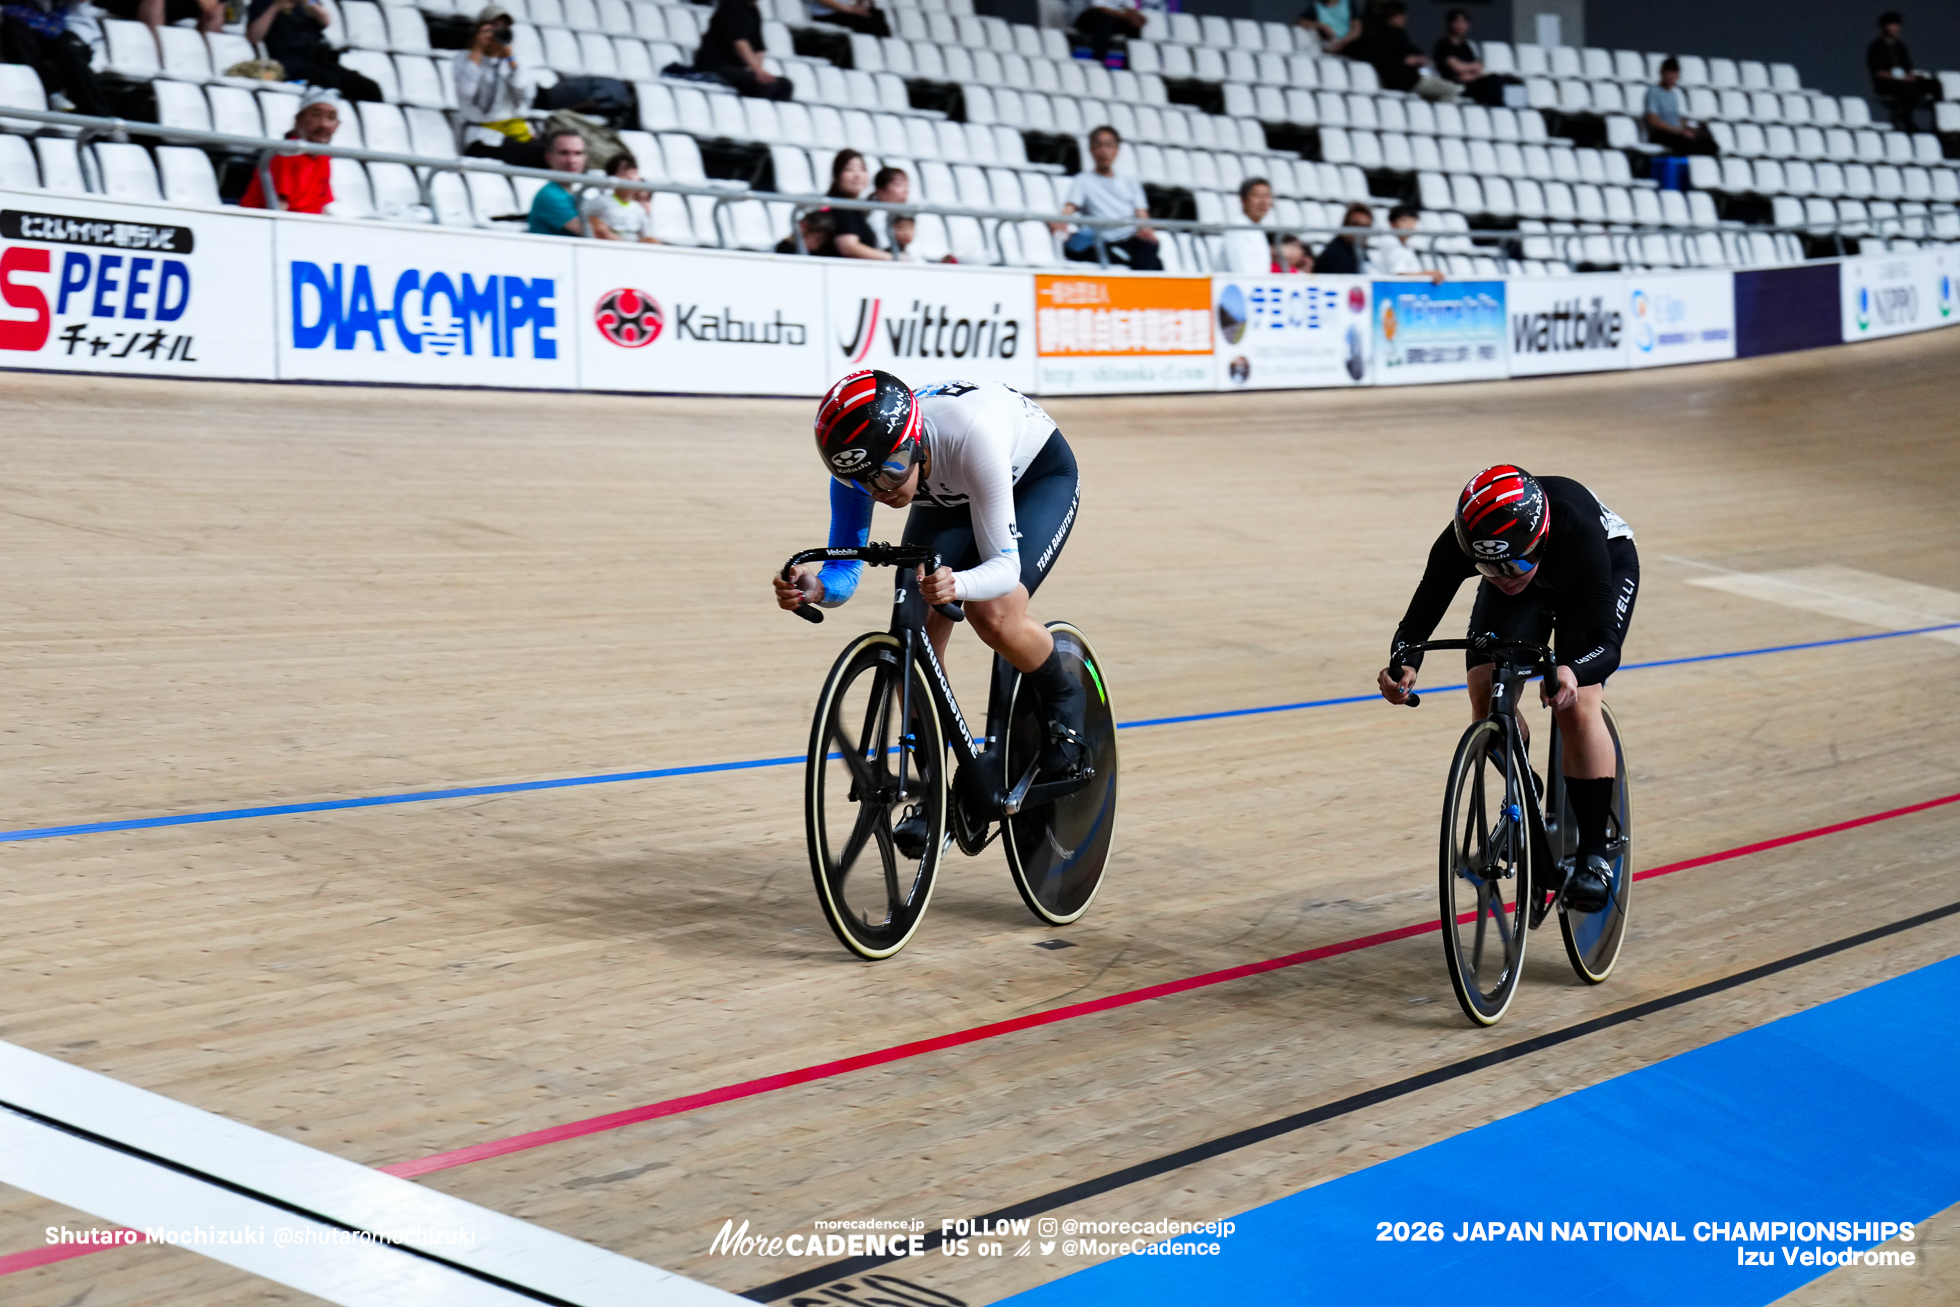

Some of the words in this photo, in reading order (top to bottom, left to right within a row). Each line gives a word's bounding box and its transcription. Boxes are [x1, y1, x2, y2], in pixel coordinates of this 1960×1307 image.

[0, 246, 190, 351] SPEED
[290, 260, 557, 360] DIA-COMPE
[676, 303, 806, 346] Kabuto
[1513, 298, 1622, 354] wattbike
[58, 323, 197, 363] チャンネル
[885, 300, 1020, 359] vittoria
[886, 390, 904, 434] JAPAN
[1530, 488, 1544, 532] JAPAN
[1036, 545, 1053, 572] TEAM
[1051, 506, 1075, 550] RAKUTEN
[921, 625, 979, 759] BRIDGESTONE
